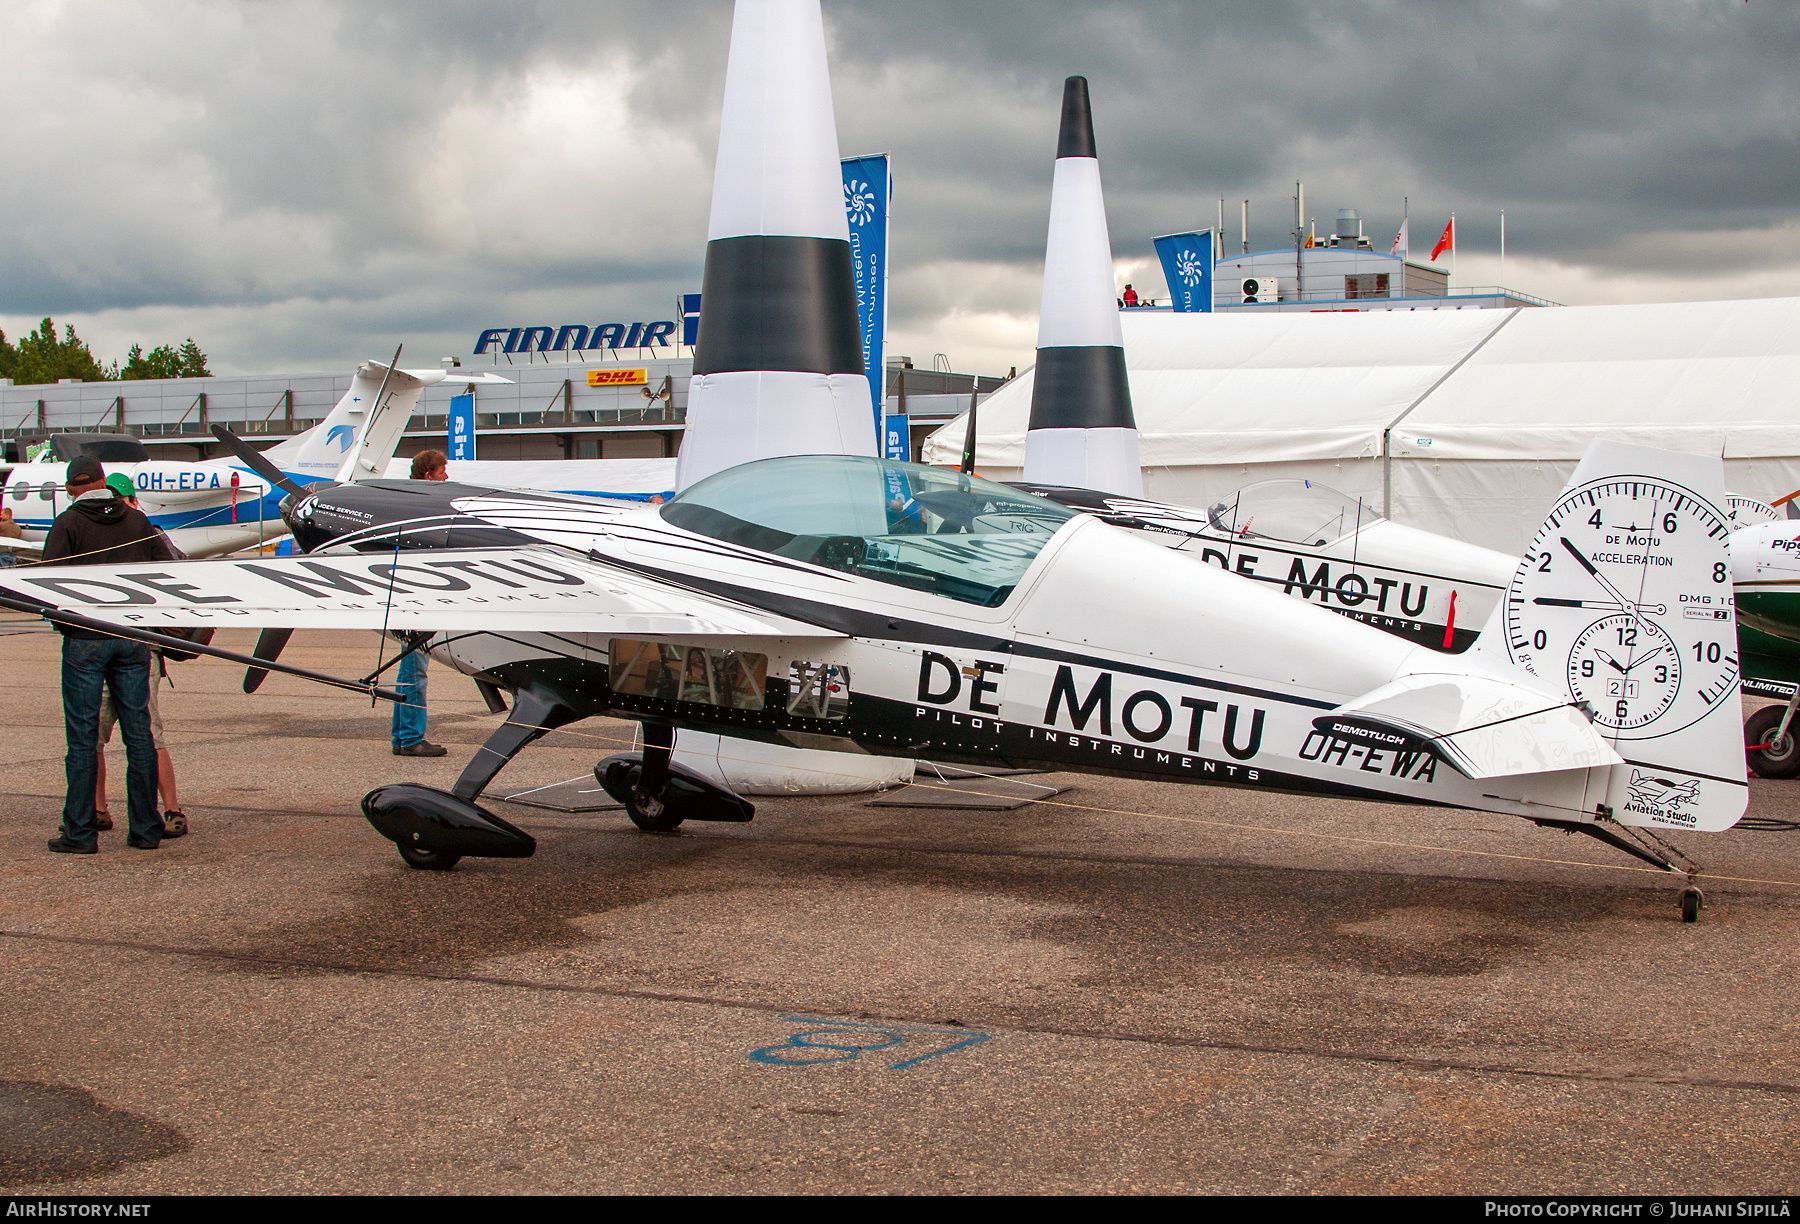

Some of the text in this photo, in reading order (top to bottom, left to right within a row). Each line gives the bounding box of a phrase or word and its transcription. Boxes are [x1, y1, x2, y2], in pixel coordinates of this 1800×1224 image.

[473, 320, 677, 355] FINNAIR
[596, 371, 638, 383] DHL
[137, 471, 221, 490] OH-EPA
[336, 507, 363, 518] SERVICE
[363, 512, 374, 520] OY
[1588, 508, 1603, 530] 4
[1662, 512, 1678, 534] 6
[1728, 510, 1737, 520] 4
[1008, 520, 1034, 534] TRIG
[1605, 535, 1620, 545] DE
[1538, 552, 1552, 573] 2
[1591, 553, 1673, 567] ACCELERATION
[1712, 562, 1727, 584] 8
[20, 572, 243, 604] DE
[1679, 594, 1712, 604] DMG
[1340, 610, 1422, 631] UMENTS
[1533, 629, 1547, 650] 0
[1616, 627, 1637, 646] 12
[1693, 641, 1721, 664] 10
[1581, 660, 1594, 678] 9
[1654, 665, 1667, 684] 3
[1740, 679, 1796, 695] NLIMITED
[917, 649, 1266, 761] DE MOTU
[1615, 700, 1628, 718] 6
[1331, 711, 1406, 745] DEMOTU.CH
[915, 707, 1261, 781] PILOT INSTRUMENTS
[1298, 729, 1439, 784] OH-EWA
[1623, 801, 1698, 823] Aviation Studio
